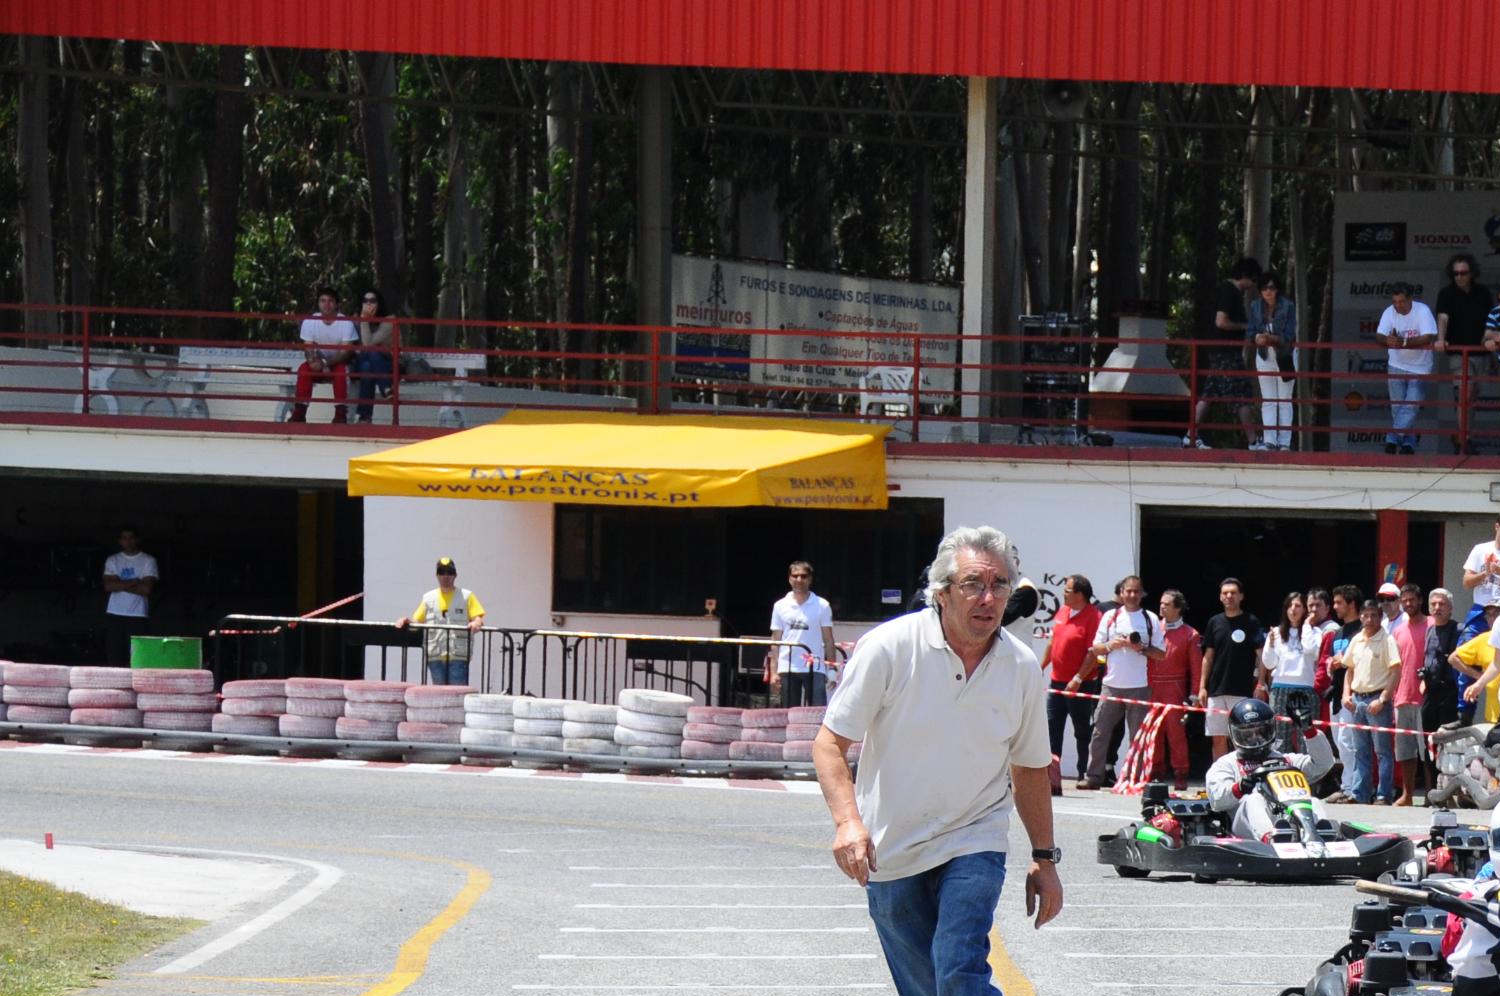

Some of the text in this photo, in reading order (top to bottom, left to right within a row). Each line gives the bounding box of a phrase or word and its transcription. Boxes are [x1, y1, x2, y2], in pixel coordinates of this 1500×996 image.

[1413, 234, 1472, 245] HONDA
[740, 275, 778, 293] FUROS
[779, 281, 786, 295] E
[788, 283, 853, 301] SONDAGENS
[856, 291, 870, 304] DE
[876, 317, 889, 328] de
[889, 317, 919, 332] Águas
[802, 341, 818, 353] Em
[470, 467, 650, 487] BALANÇAS
[788, 476, 857, 491] BALANÇAS
[418, 482, 701, 504] www.pestronix.pt
[1276, 773, 1306, 789] 100
